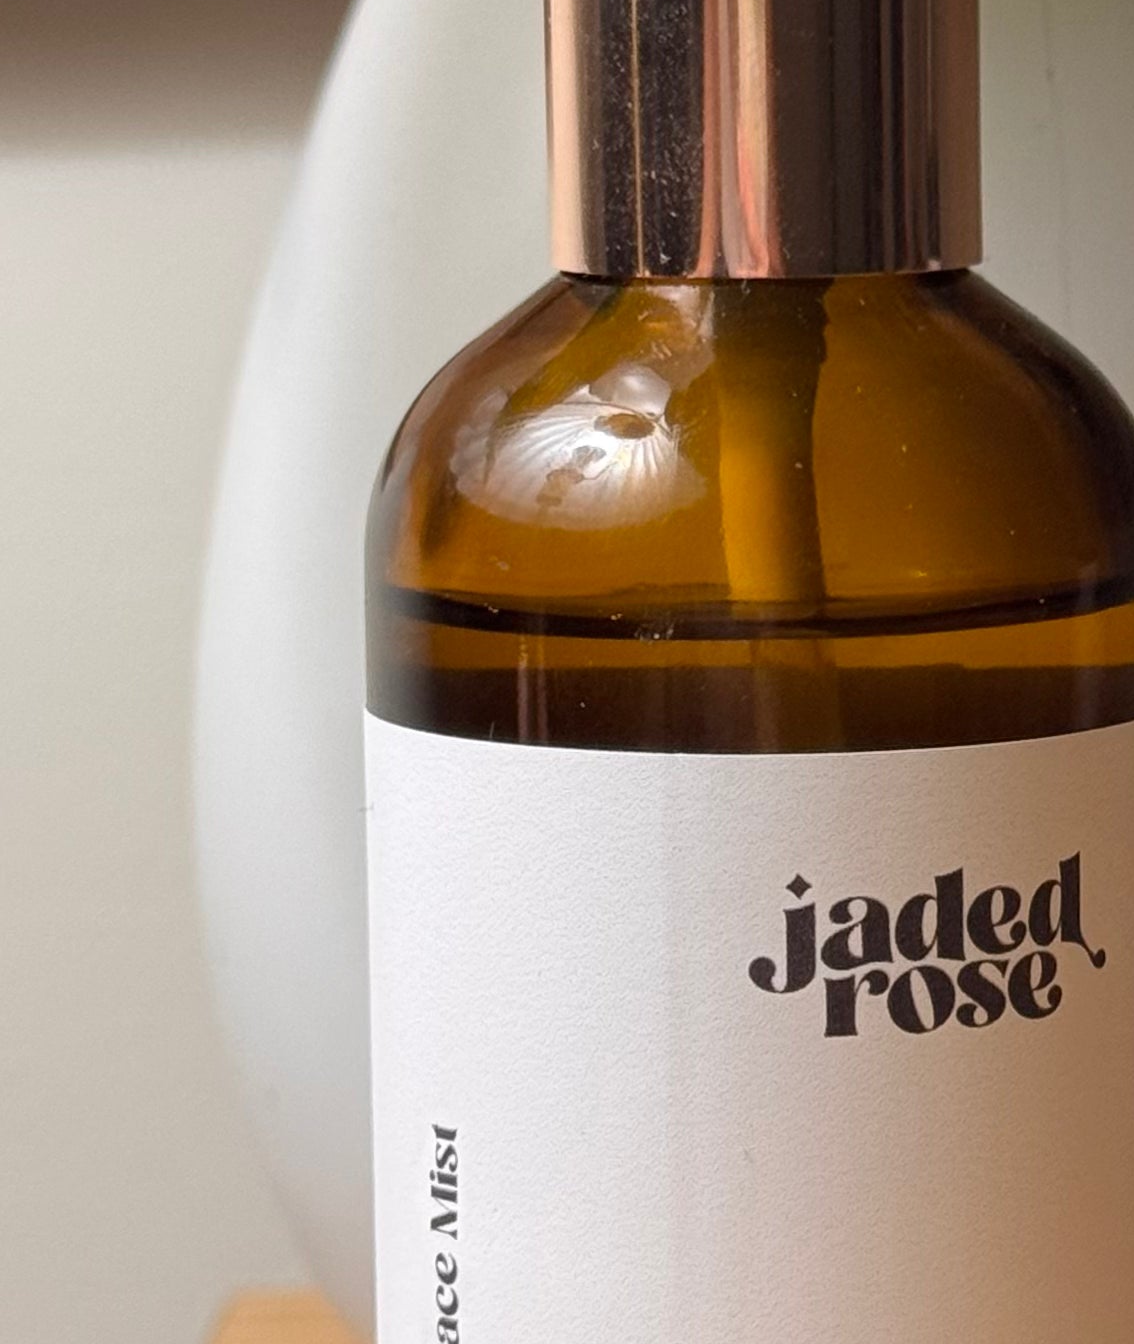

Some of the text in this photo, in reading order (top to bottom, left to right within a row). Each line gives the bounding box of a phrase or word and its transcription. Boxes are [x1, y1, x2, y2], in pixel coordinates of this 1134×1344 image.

[748, 851, 1106, 994] jaded
[823, 949, 1063, 1038] rose
[429, 1123, 459, 1241] Mist
